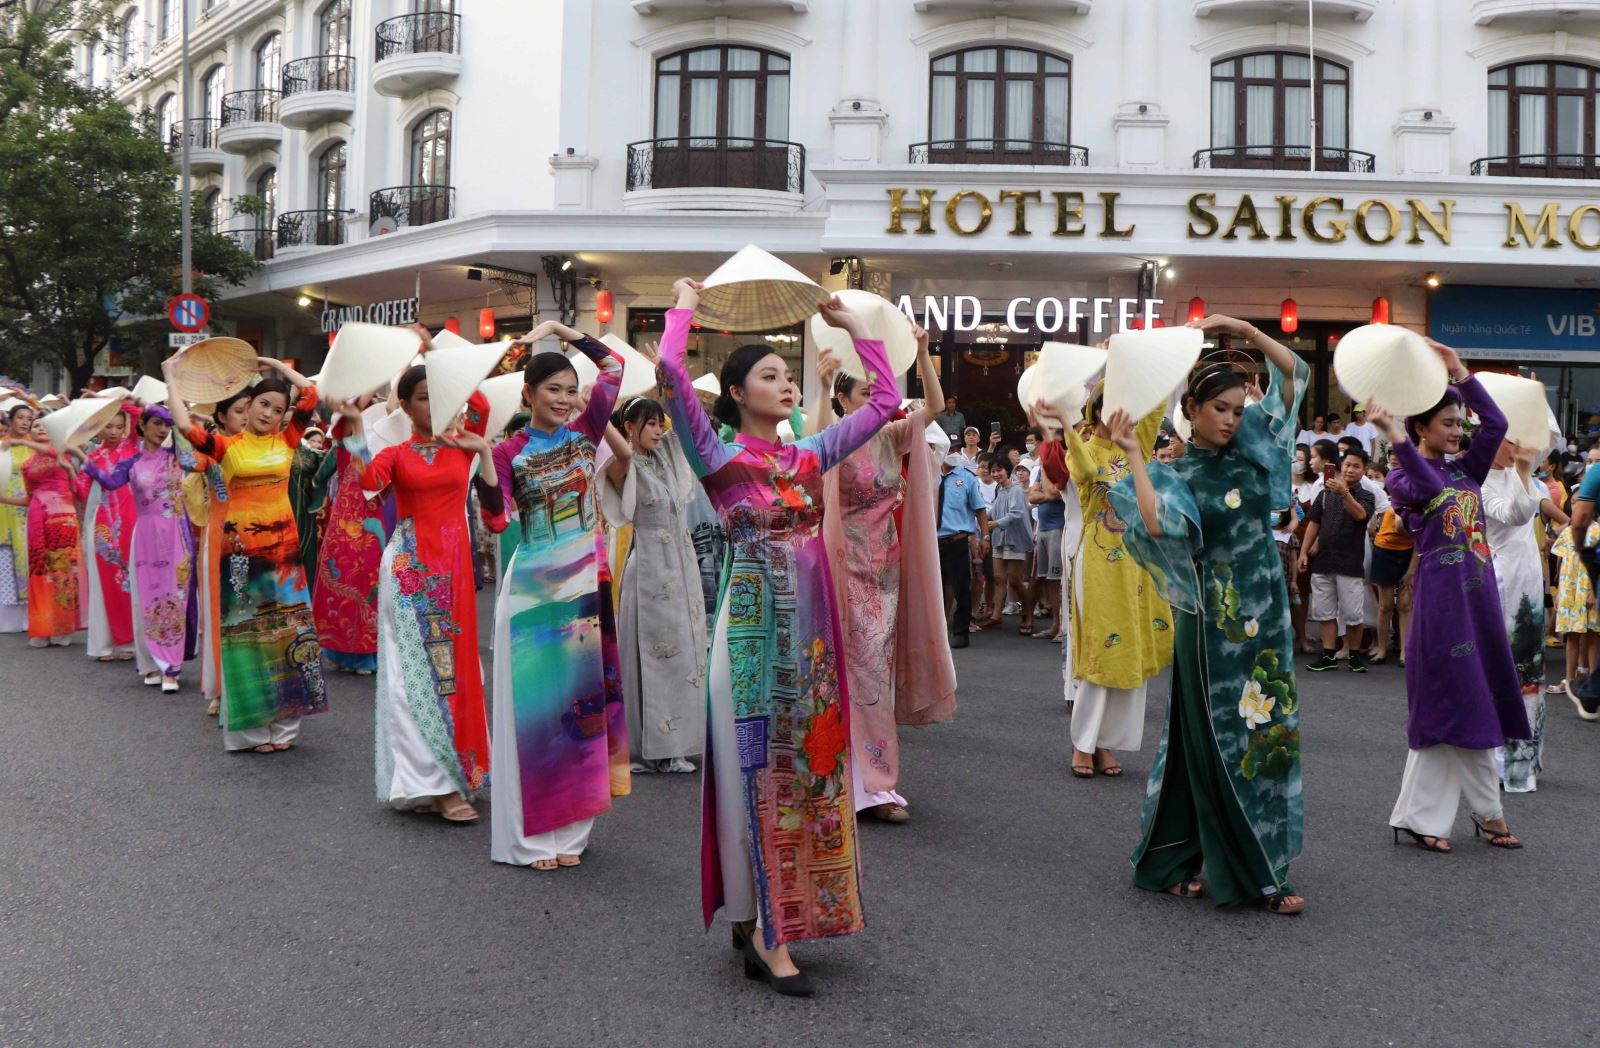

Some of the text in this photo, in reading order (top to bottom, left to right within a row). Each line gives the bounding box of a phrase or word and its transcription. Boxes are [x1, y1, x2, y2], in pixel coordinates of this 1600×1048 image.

[885, 188, 1136, 238] HOTEL
[1186, 192, 1456, 245] SAIGON
[321, 298, 416, 333] GRAND COFFEE
[1006, 296, 1164, 334] COFFEE
[1546, 313, 1596, 337] VIB
